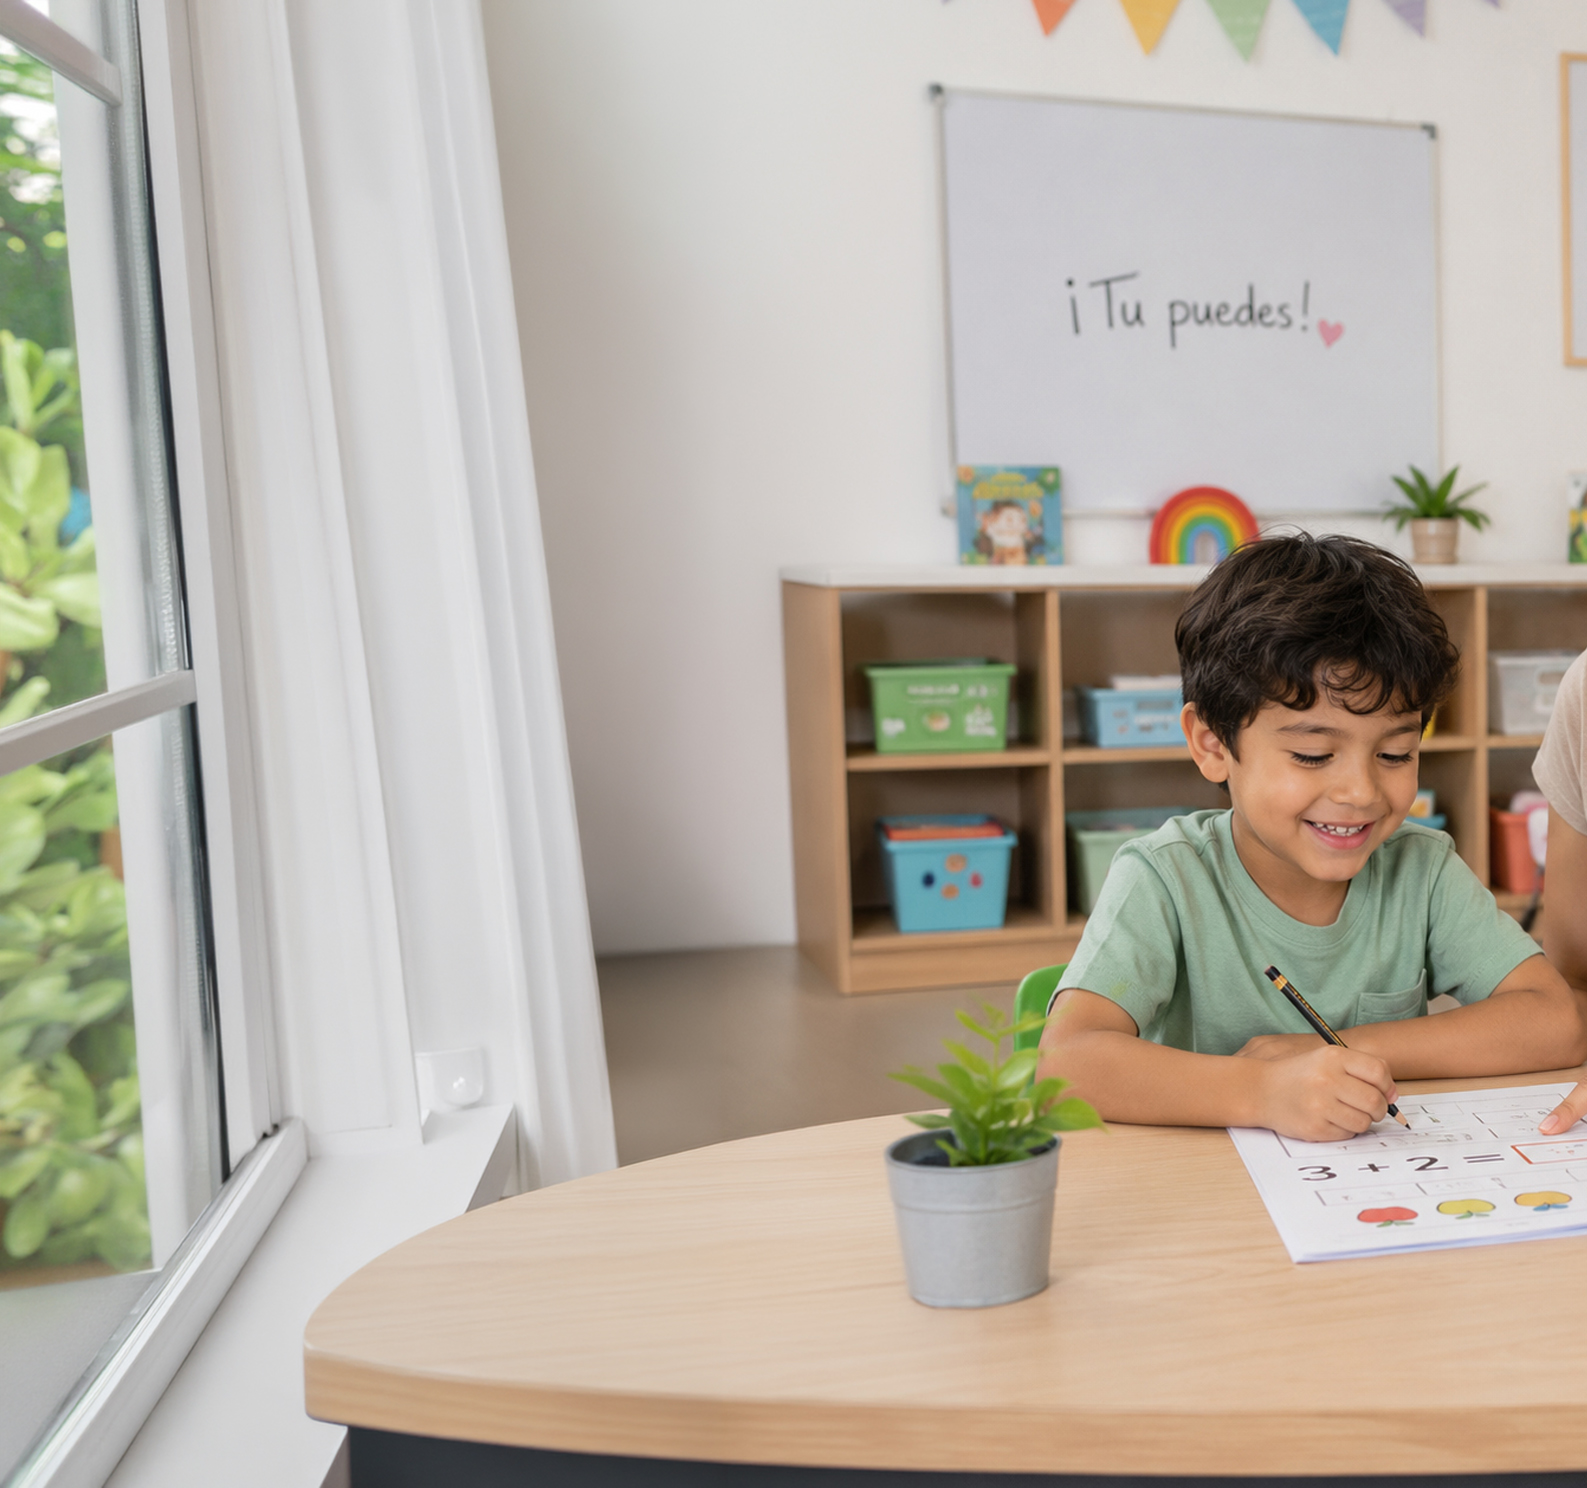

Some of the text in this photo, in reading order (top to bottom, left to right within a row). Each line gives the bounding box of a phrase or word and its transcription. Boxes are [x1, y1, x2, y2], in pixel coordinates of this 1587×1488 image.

[1065, 271, 1311, 349] ¡Tu puedes!
[1297, 1165, 1338, 1181] 3
[1406, 1156, 1449, 1172] 2
